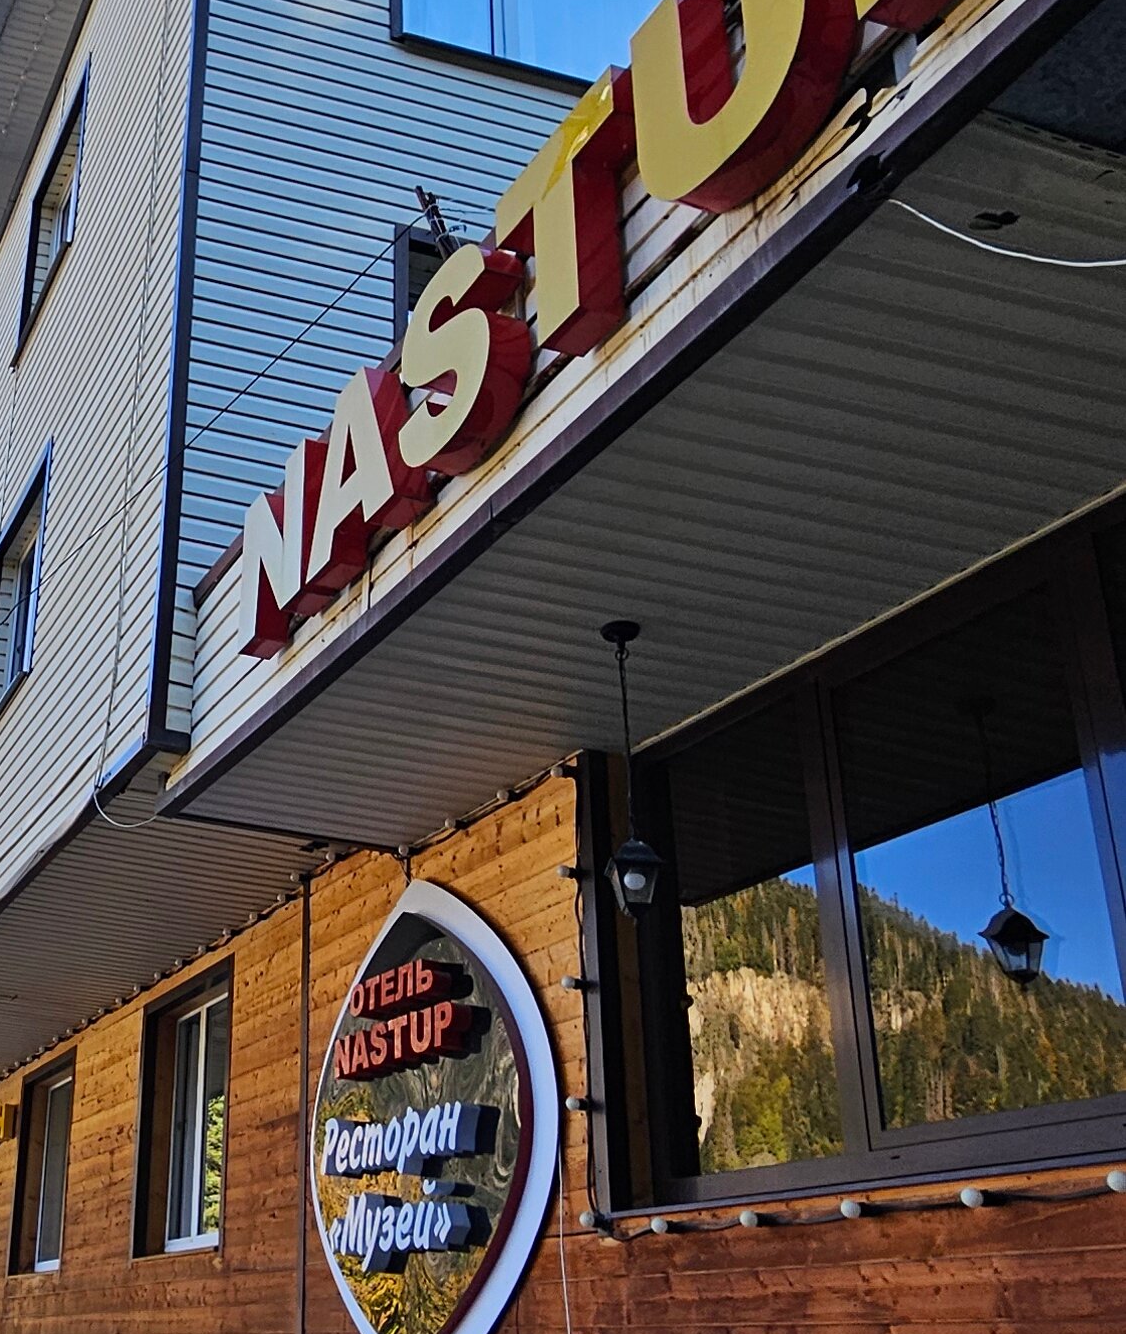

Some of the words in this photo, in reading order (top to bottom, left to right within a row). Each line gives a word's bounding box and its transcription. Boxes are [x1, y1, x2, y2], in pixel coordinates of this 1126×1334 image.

[349, 958, 434, 1017] ОТЕЛЬ
[333, 1000, 453, 1079] NASTUP
[320, 1100, 462, 1174] Ресторан
[325, 1179, 452, 1273] «Музей»
